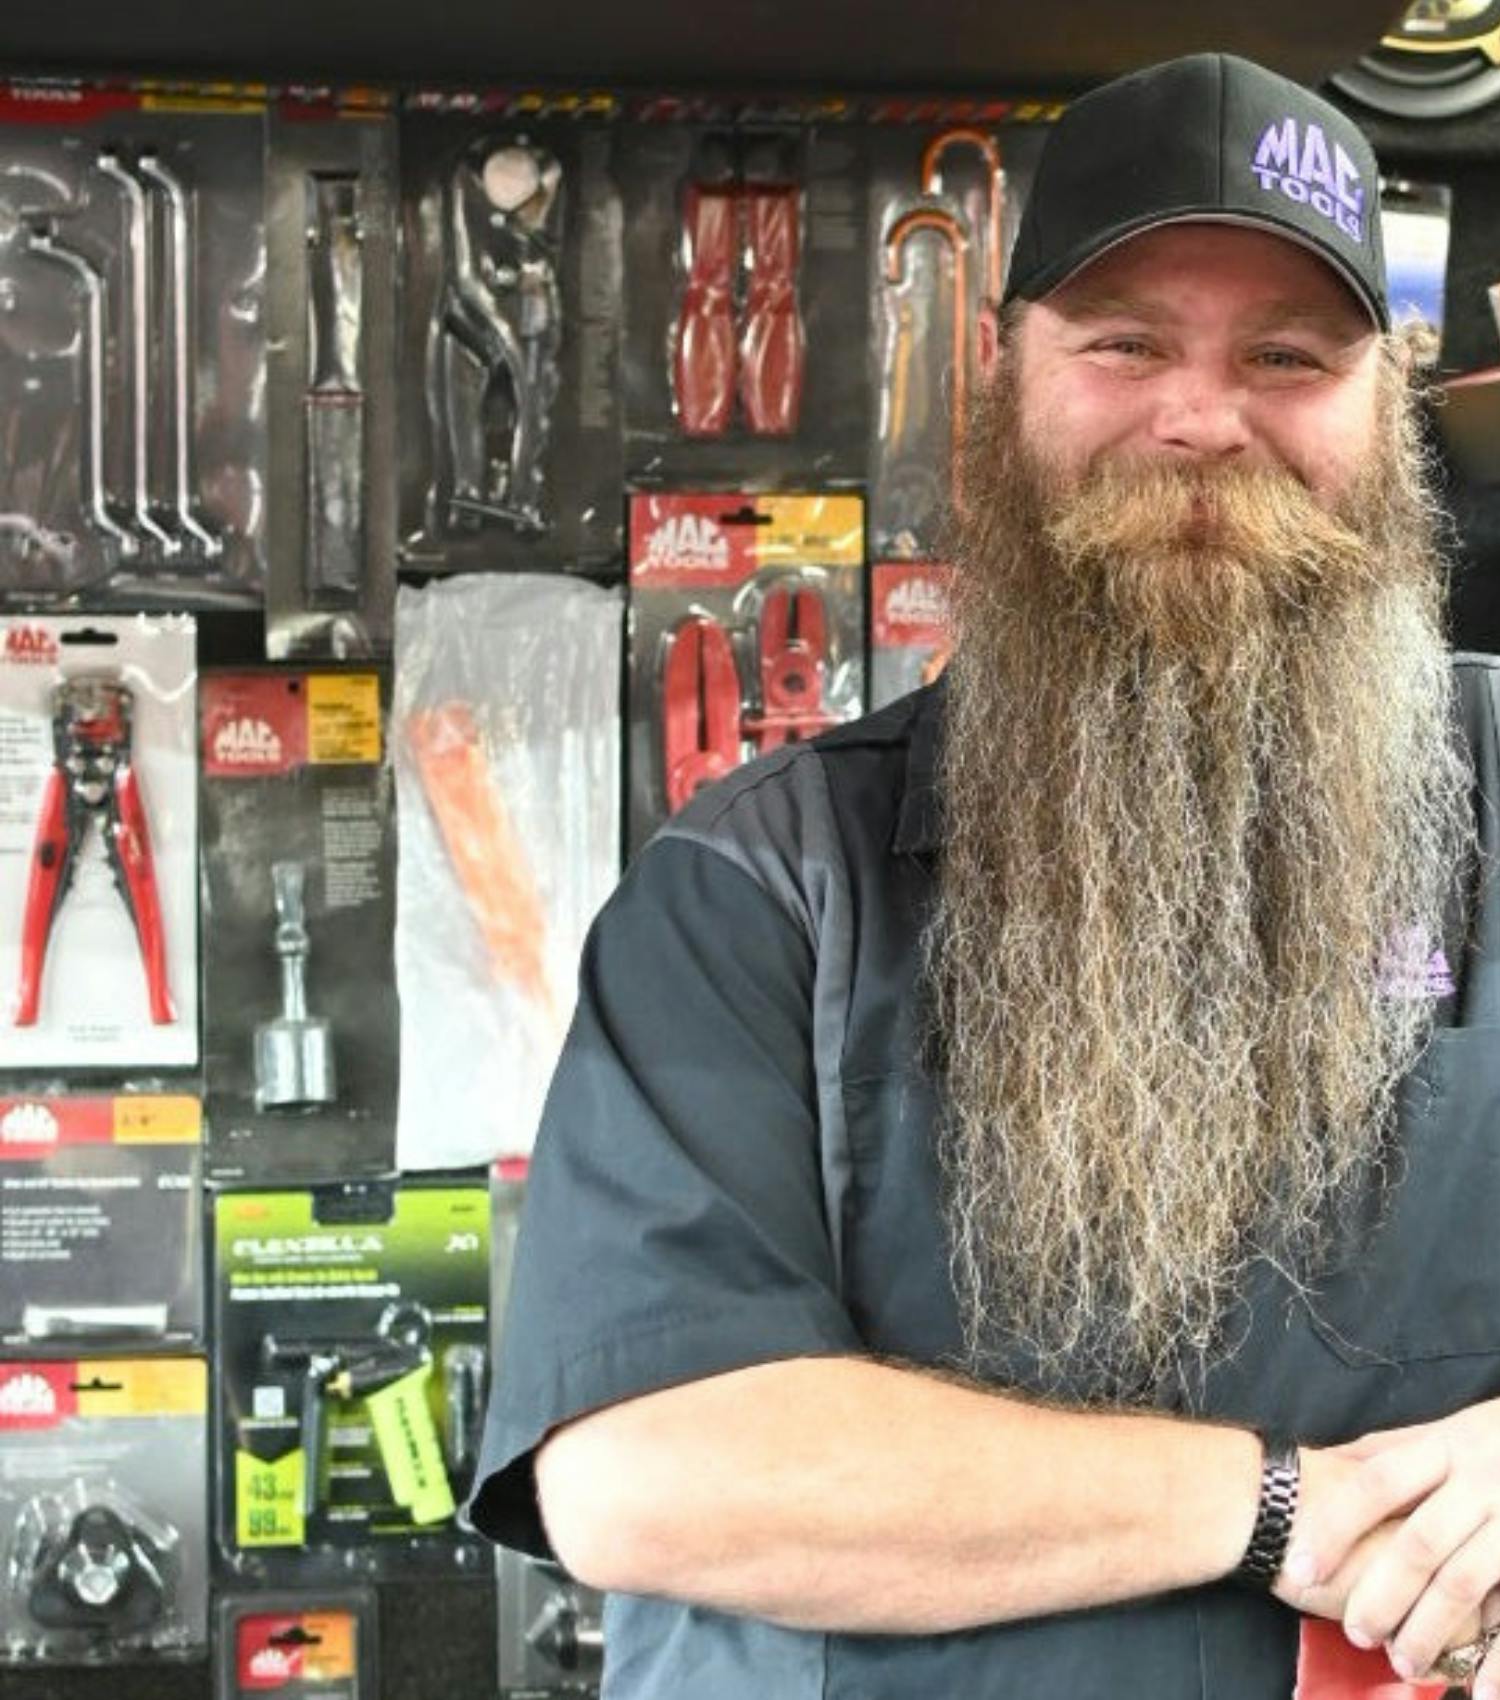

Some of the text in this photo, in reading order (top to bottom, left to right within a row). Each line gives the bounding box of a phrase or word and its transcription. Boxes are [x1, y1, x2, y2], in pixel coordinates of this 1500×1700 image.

[1254, 117, 1363, 213] MAC
[1250, 165, 1363, 242] TOOLS
[648, 514, 729, 556] MAC
[215, 717, 281, 750] MAC
